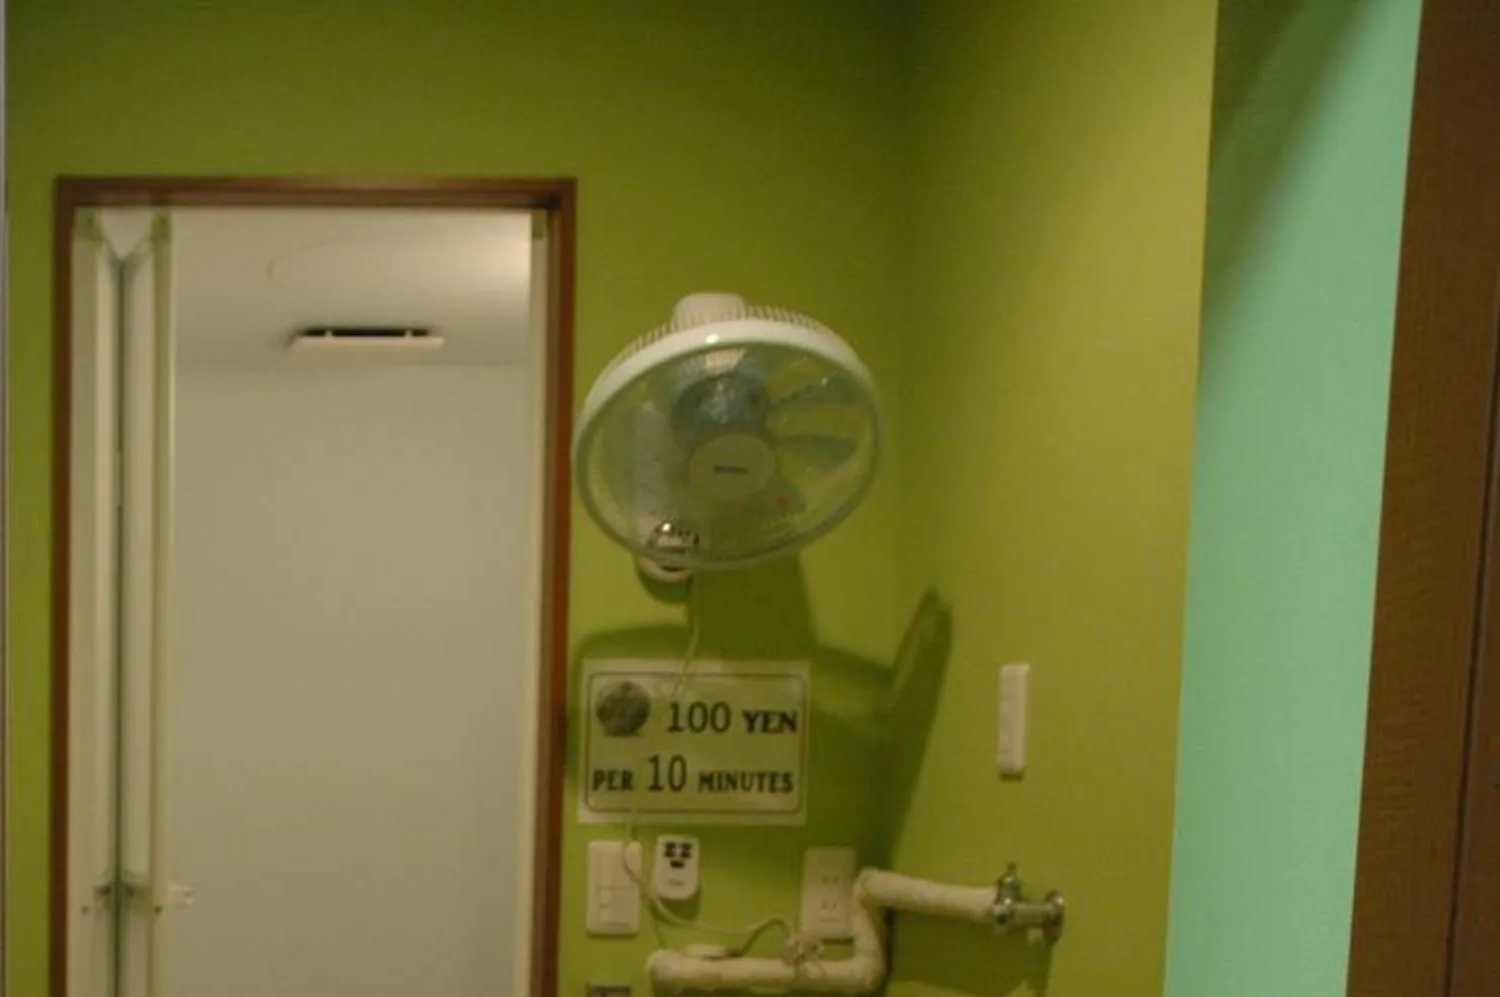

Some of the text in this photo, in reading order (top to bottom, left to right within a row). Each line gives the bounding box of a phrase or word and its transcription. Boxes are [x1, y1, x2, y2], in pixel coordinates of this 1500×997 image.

[666, 701, 798, 735] 100 YEN
[592, 753, 794, 794] PER 10 MINUTES
